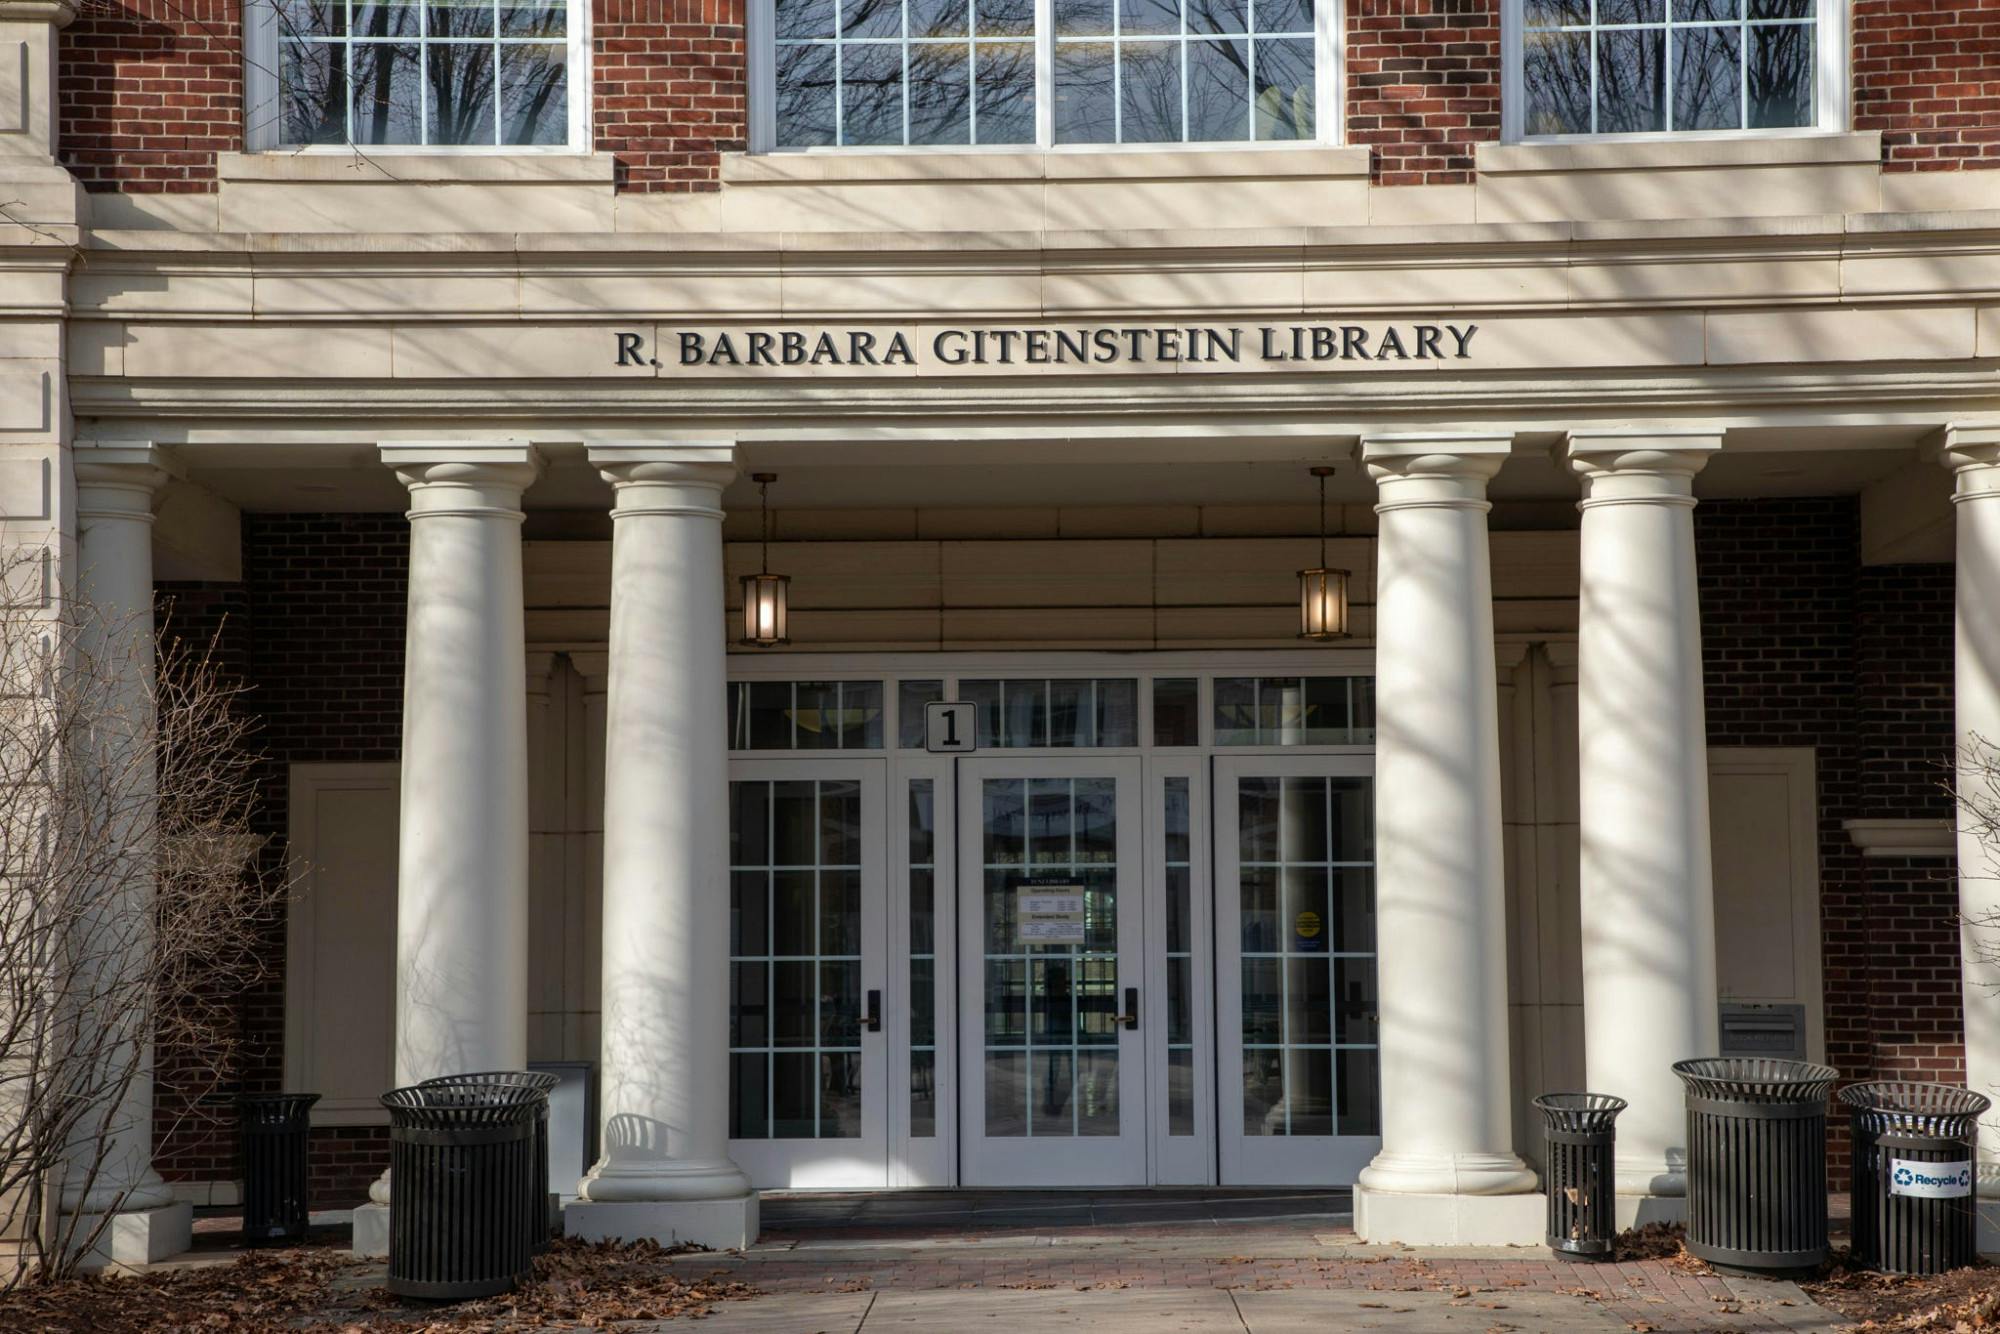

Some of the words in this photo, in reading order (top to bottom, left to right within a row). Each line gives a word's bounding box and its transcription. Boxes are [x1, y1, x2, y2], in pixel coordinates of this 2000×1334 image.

[615, 332, 657, 367] R.
[677, 331, 916, 367] BARBARA
[933, 328, 1239, 365] GITENSTEIN
[1258, 324, 1476, 361] LIBRARY
[941, 709, 961, 746] 1
[1915, 1173, 1958, 1188] Recycle
